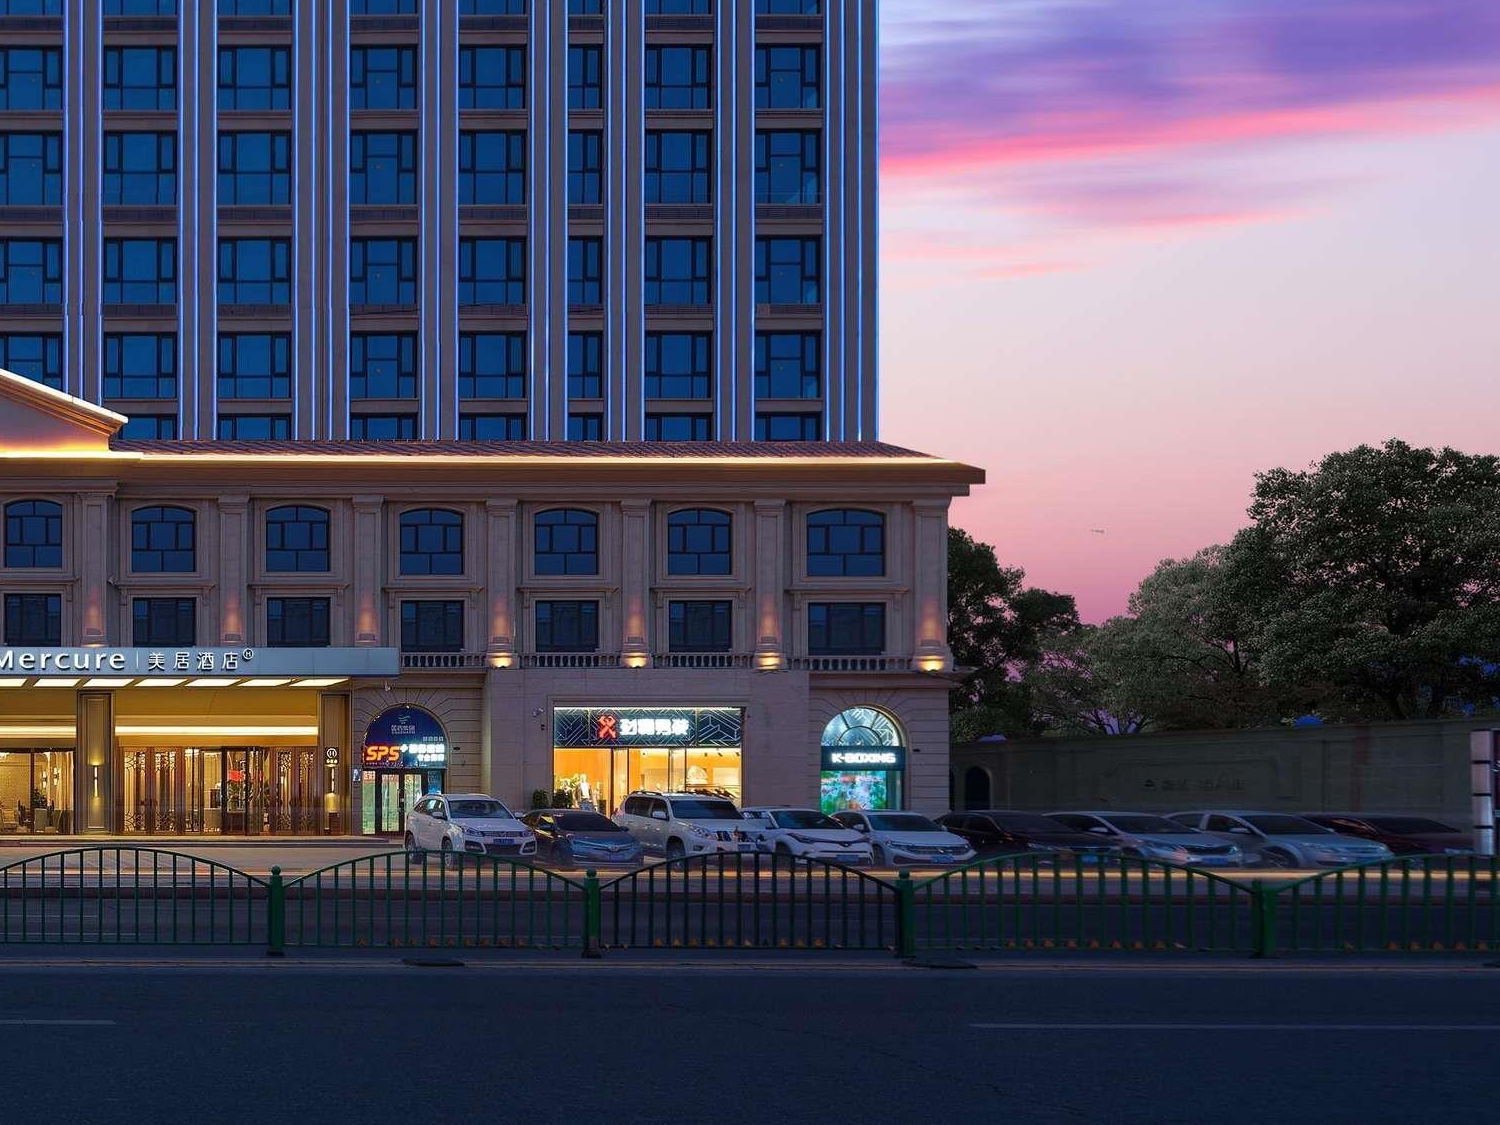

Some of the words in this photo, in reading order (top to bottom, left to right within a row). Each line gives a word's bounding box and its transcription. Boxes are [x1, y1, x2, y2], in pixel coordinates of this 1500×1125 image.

[148, 651, 239, 670] 美居酒店
[831, 752, 897, 764] K-BOXING
